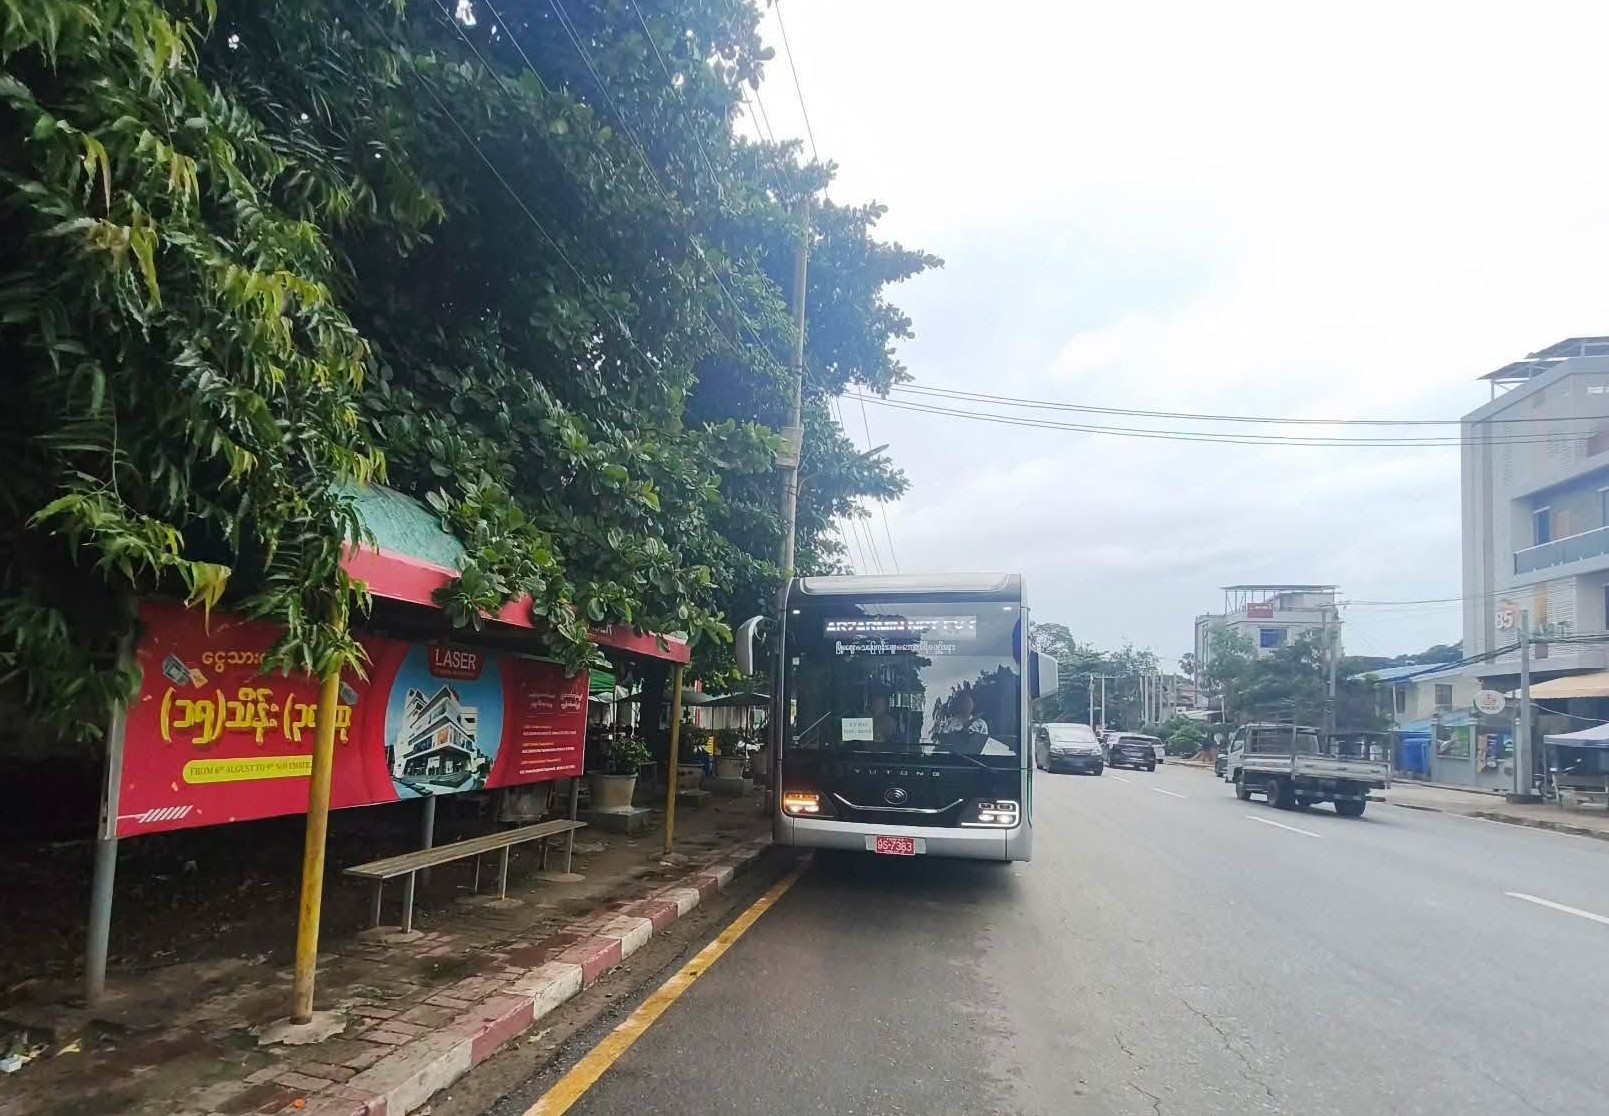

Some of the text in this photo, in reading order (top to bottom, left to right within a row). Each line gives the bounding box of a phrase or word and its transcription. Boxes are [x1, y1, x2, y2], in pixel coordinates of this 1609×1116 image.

[435, 648, 476, 670] LASER
[190, 765, 212, 776] FROM
[854, 767, 940, 777] YUTONG
